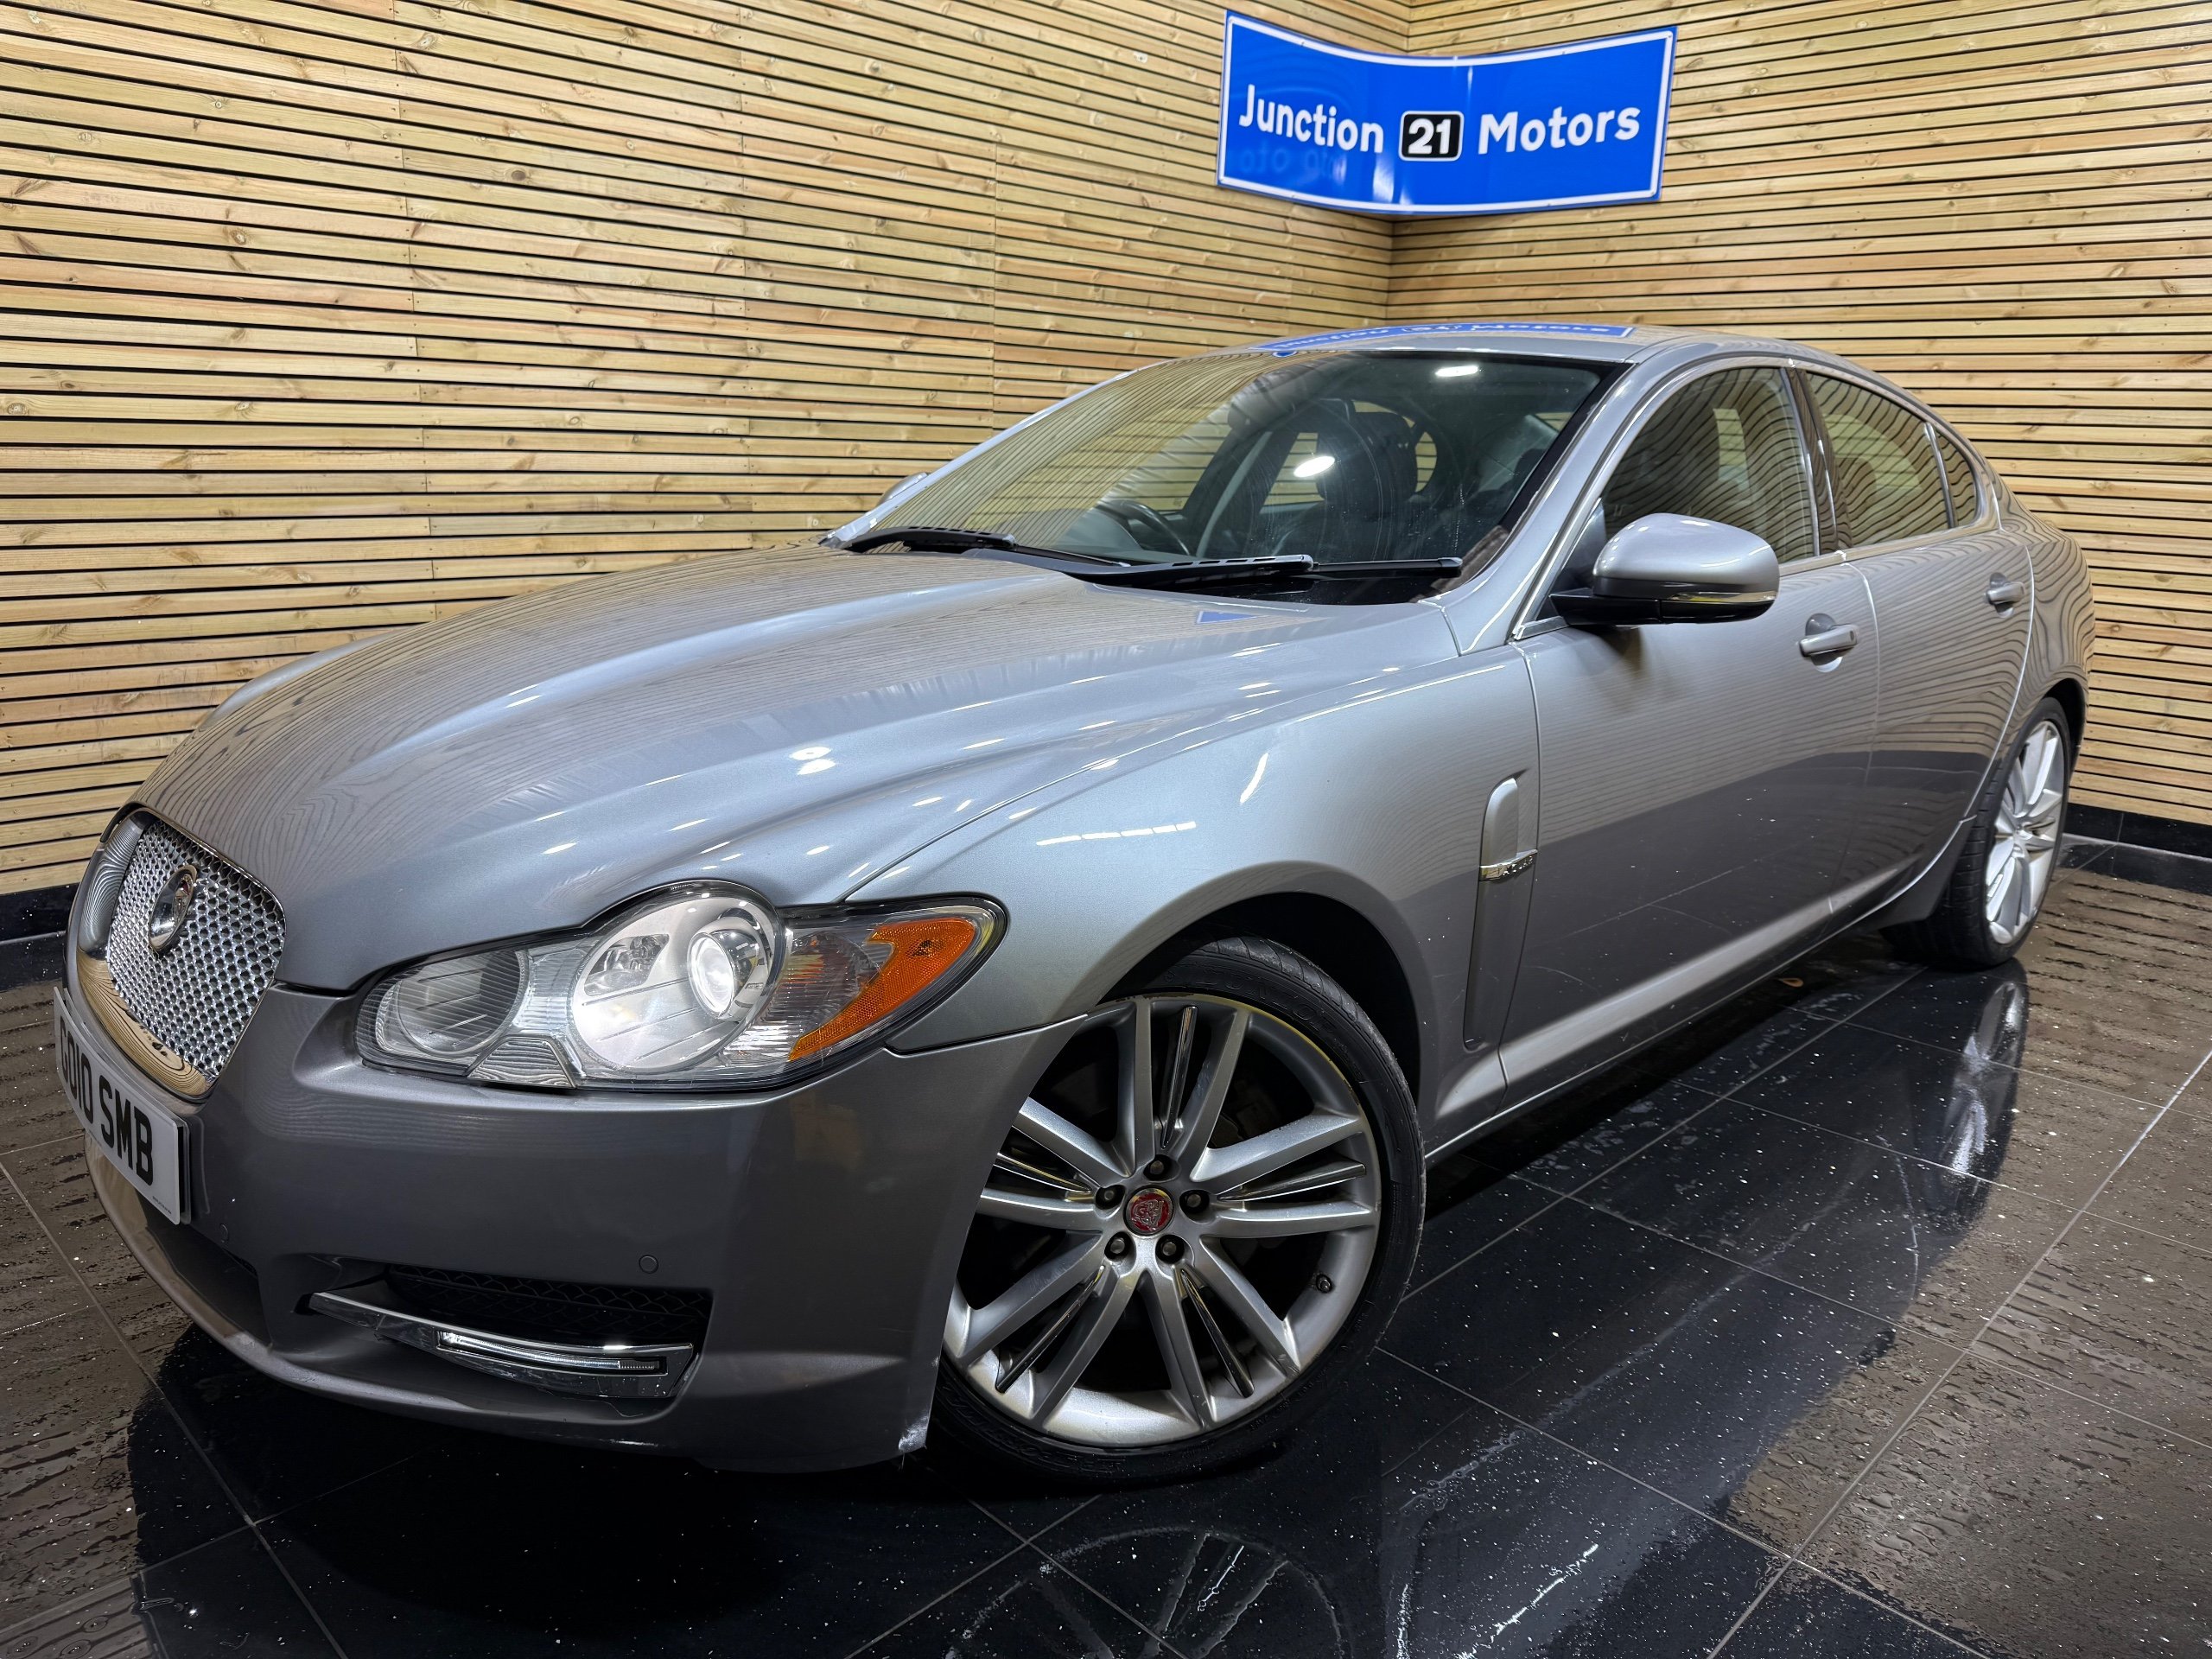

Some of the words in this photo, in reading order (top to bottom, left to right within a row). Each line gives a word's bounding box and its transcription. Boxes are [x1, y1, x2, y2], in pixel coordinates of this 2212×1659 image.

[1238, 84, 1384, 154] Junction
[1408, 118, 1452, 155] 21
[1478, 106, 1641, 155] Motors
[99, 1075, 154, 1185] SMB
